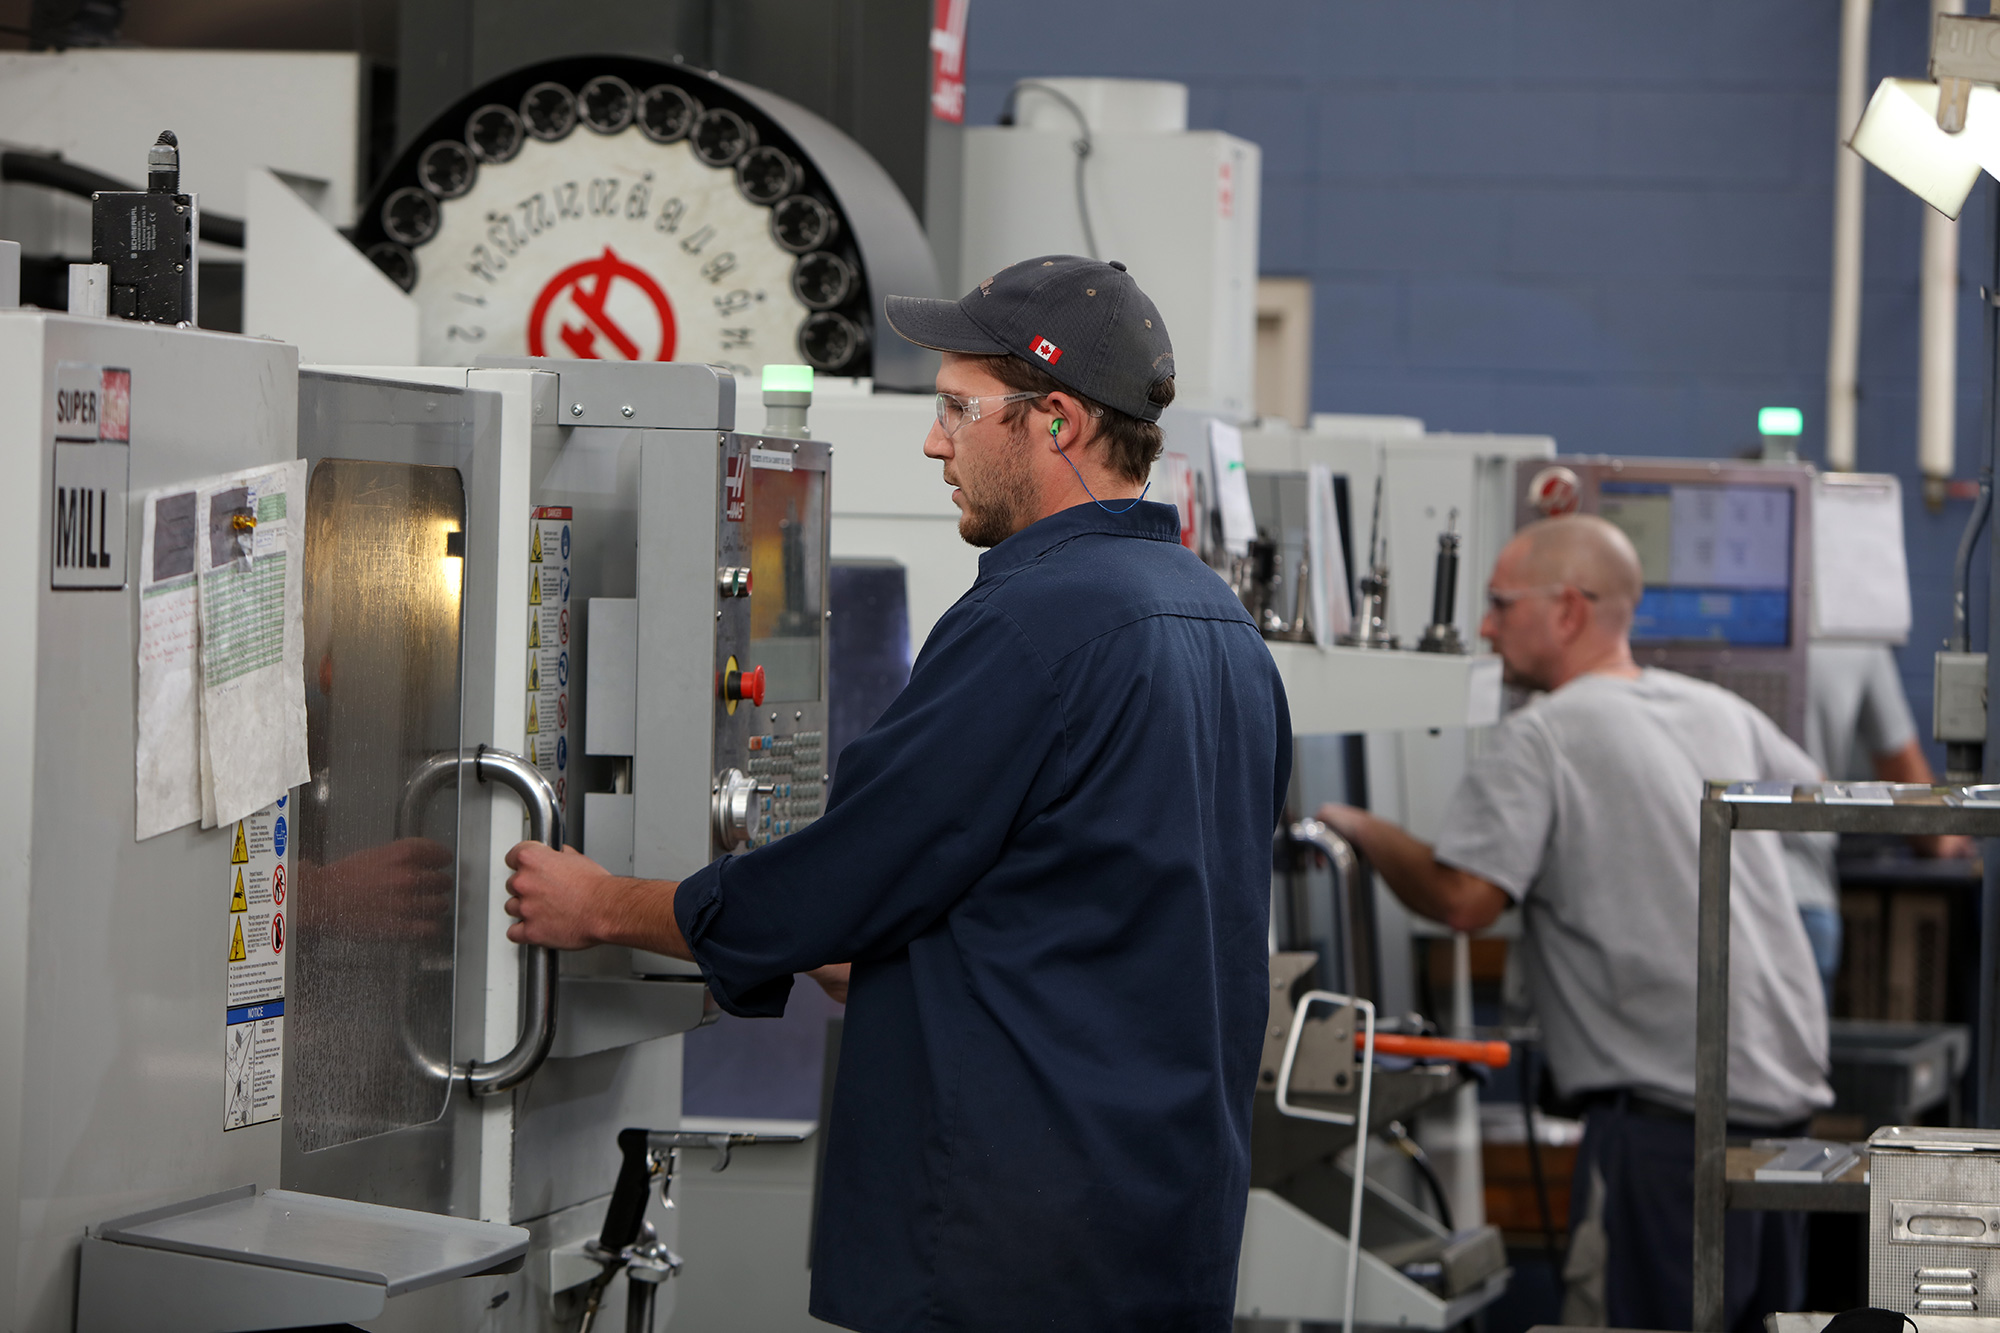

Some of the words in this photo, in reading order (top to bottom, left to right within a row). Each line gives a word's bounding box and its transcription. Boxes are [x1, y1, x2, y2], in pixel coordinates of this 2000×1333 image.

[58, 388, 97, 423] SUPER
[57, 487, 110, 568] MILL
[247, 1006, 264, 1018] NOTICE
